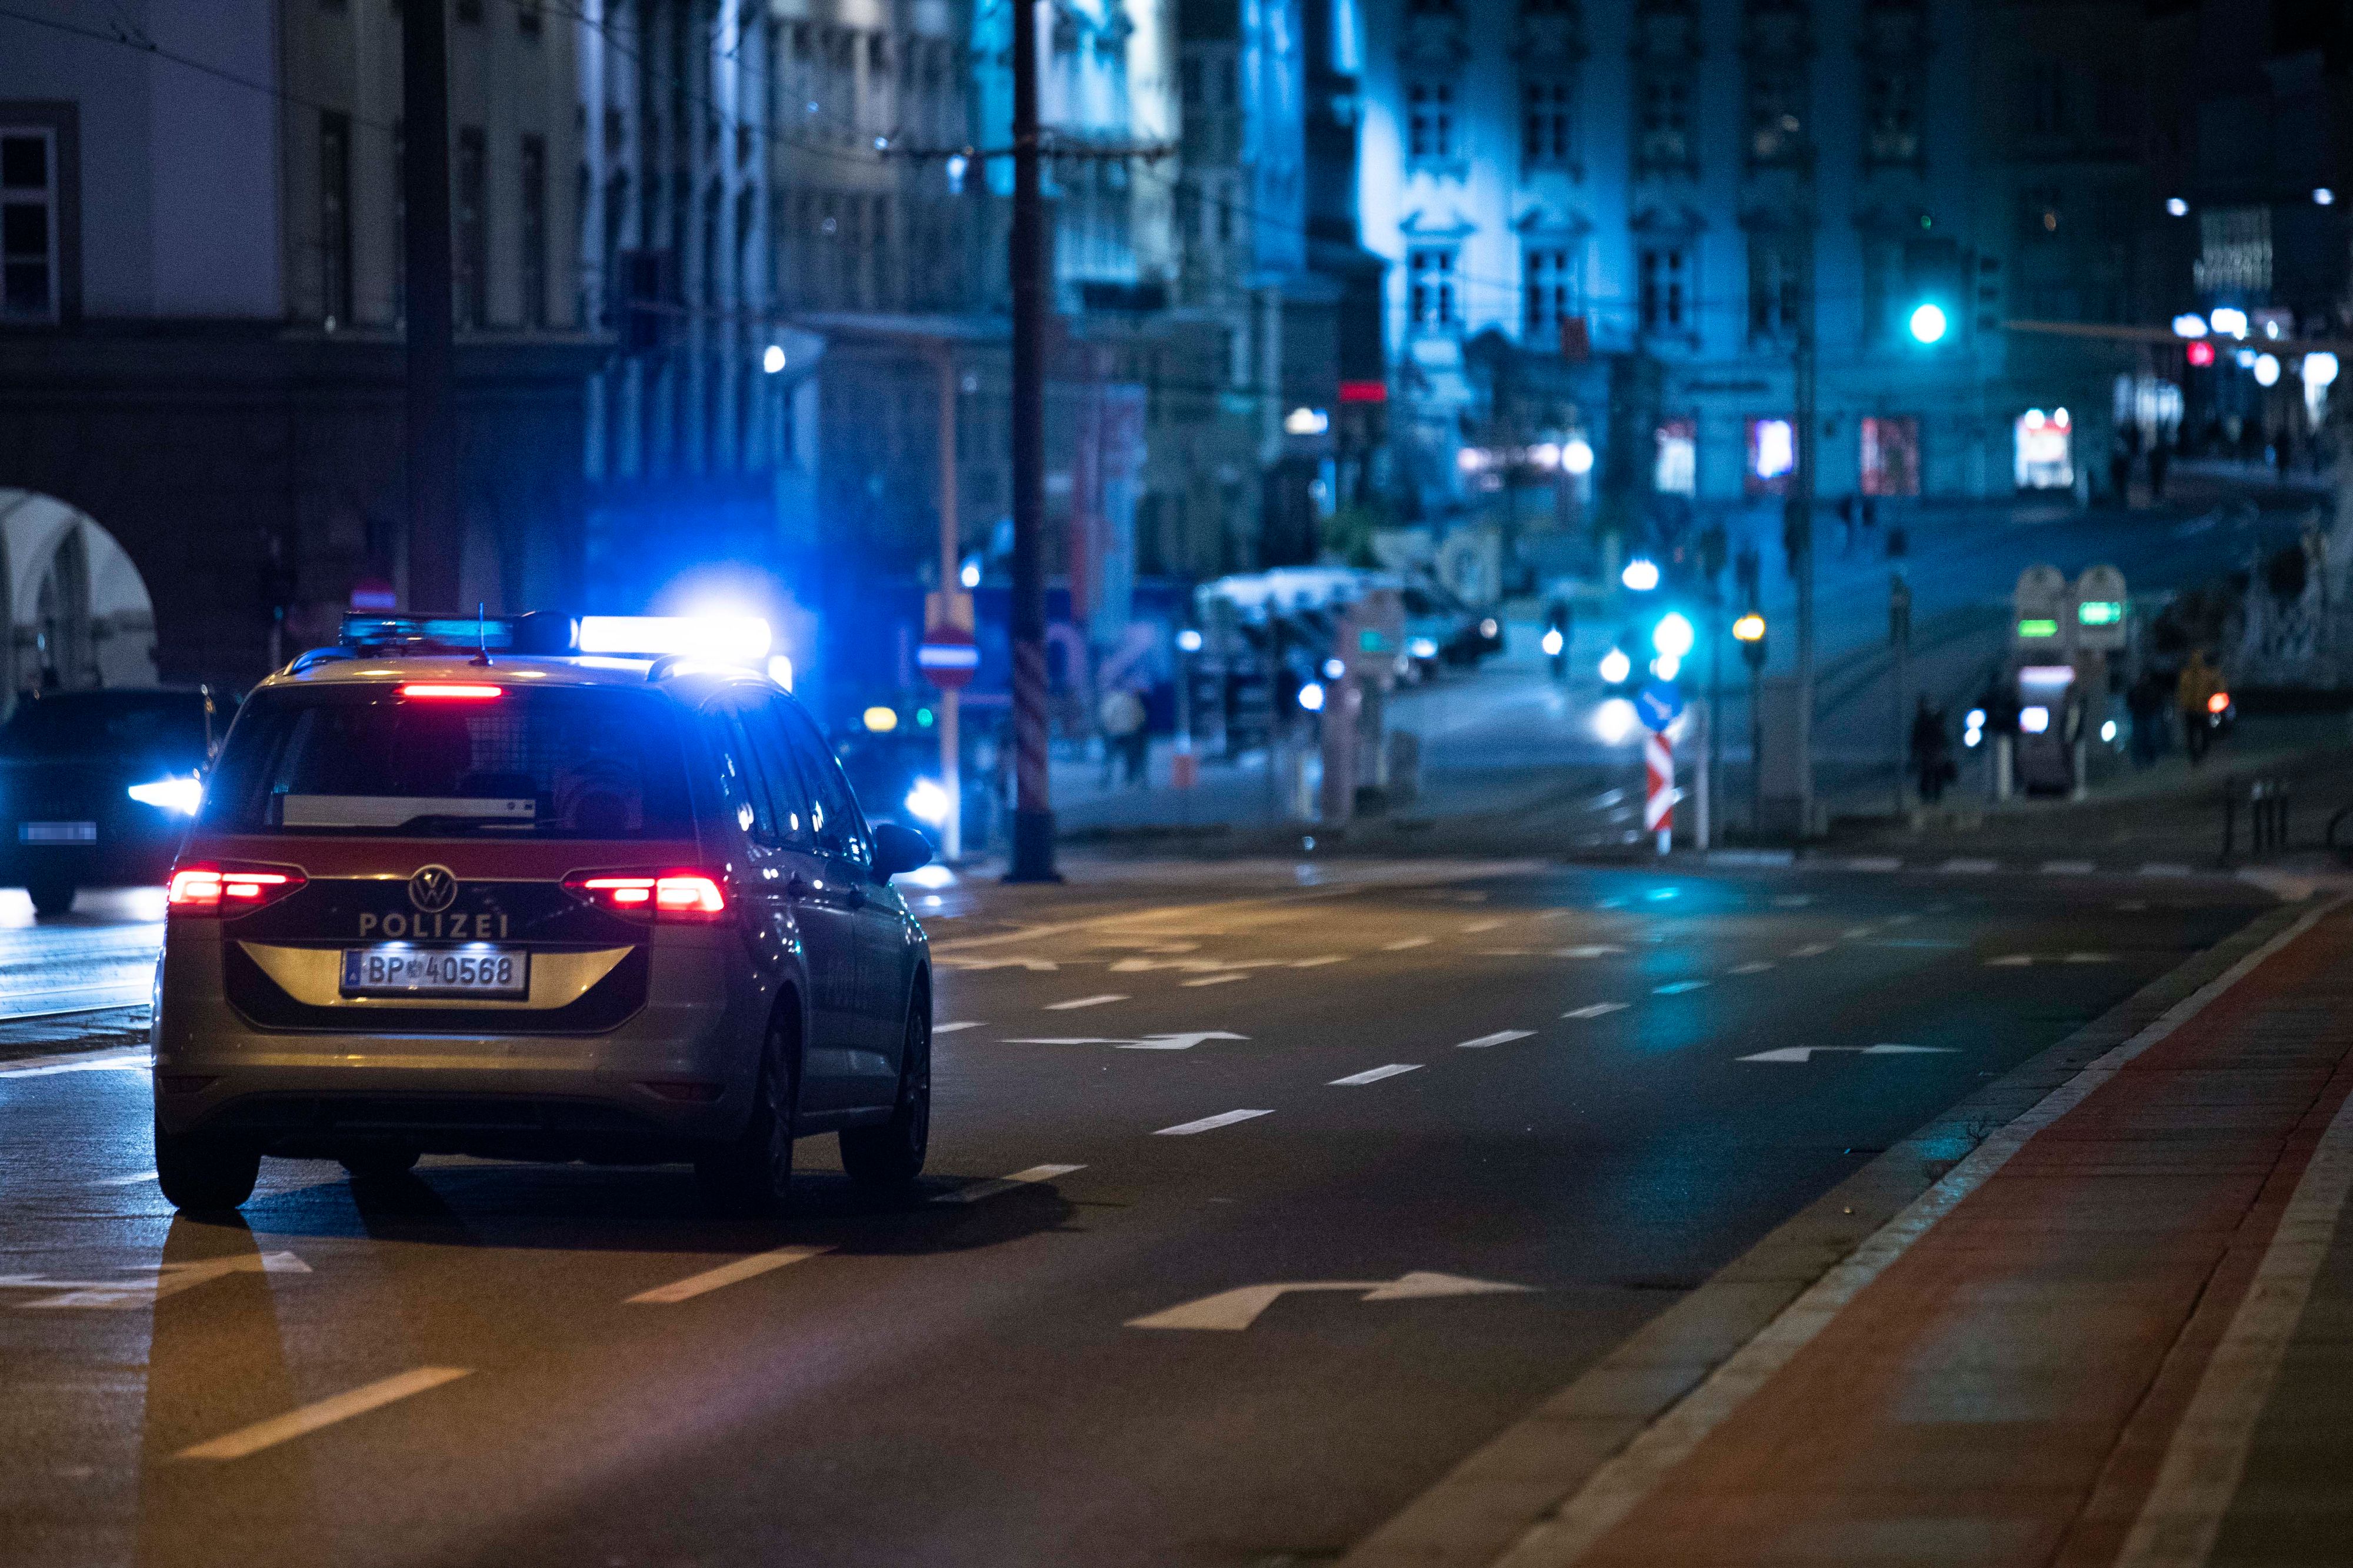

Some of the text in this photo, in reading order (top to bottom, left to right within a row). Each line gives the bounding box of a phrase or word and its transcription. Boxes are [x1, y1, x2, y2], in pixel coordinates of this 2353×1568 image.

[412, 868, 454, 908] VW
[359, 913, 508, 938] POLIZEI
[369, 956, 404, 983] BP
[426, 956, 512, 984] 40568
